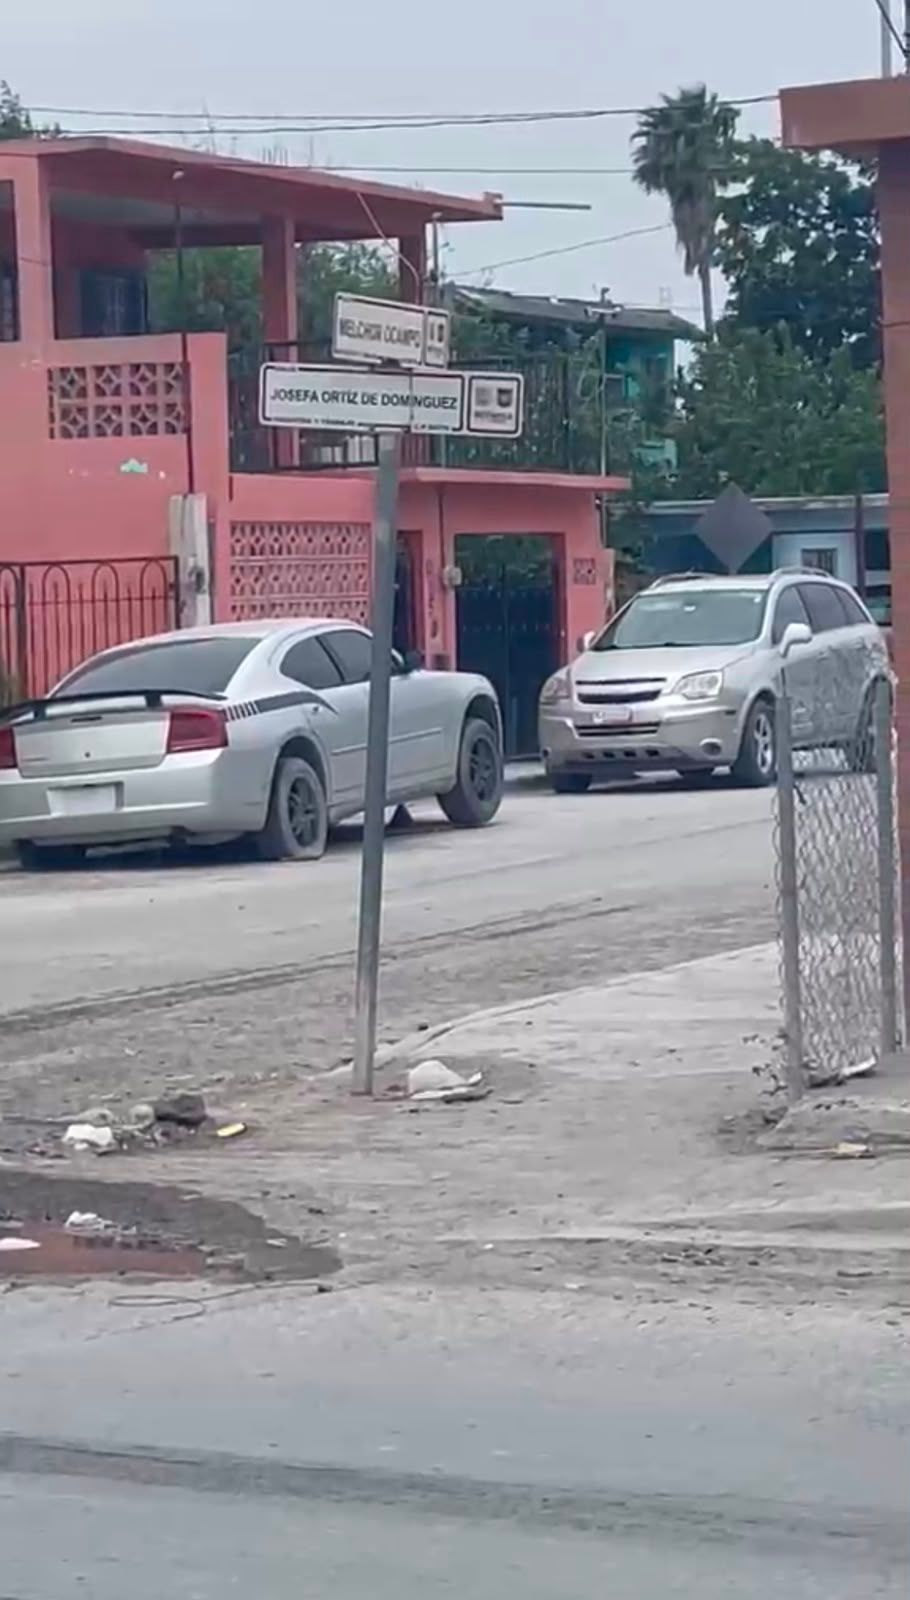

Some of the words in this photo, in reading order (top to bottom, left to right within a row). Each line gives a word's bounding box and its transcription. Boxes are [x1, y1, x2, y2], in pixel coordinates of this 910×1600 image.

[340, 320, 382, 341] MELCHOR
[384, 325, 421, 347] OCAMPO
[270, 388, 319, 402] JOSEFA
[361, 392, 378, 405] DE
